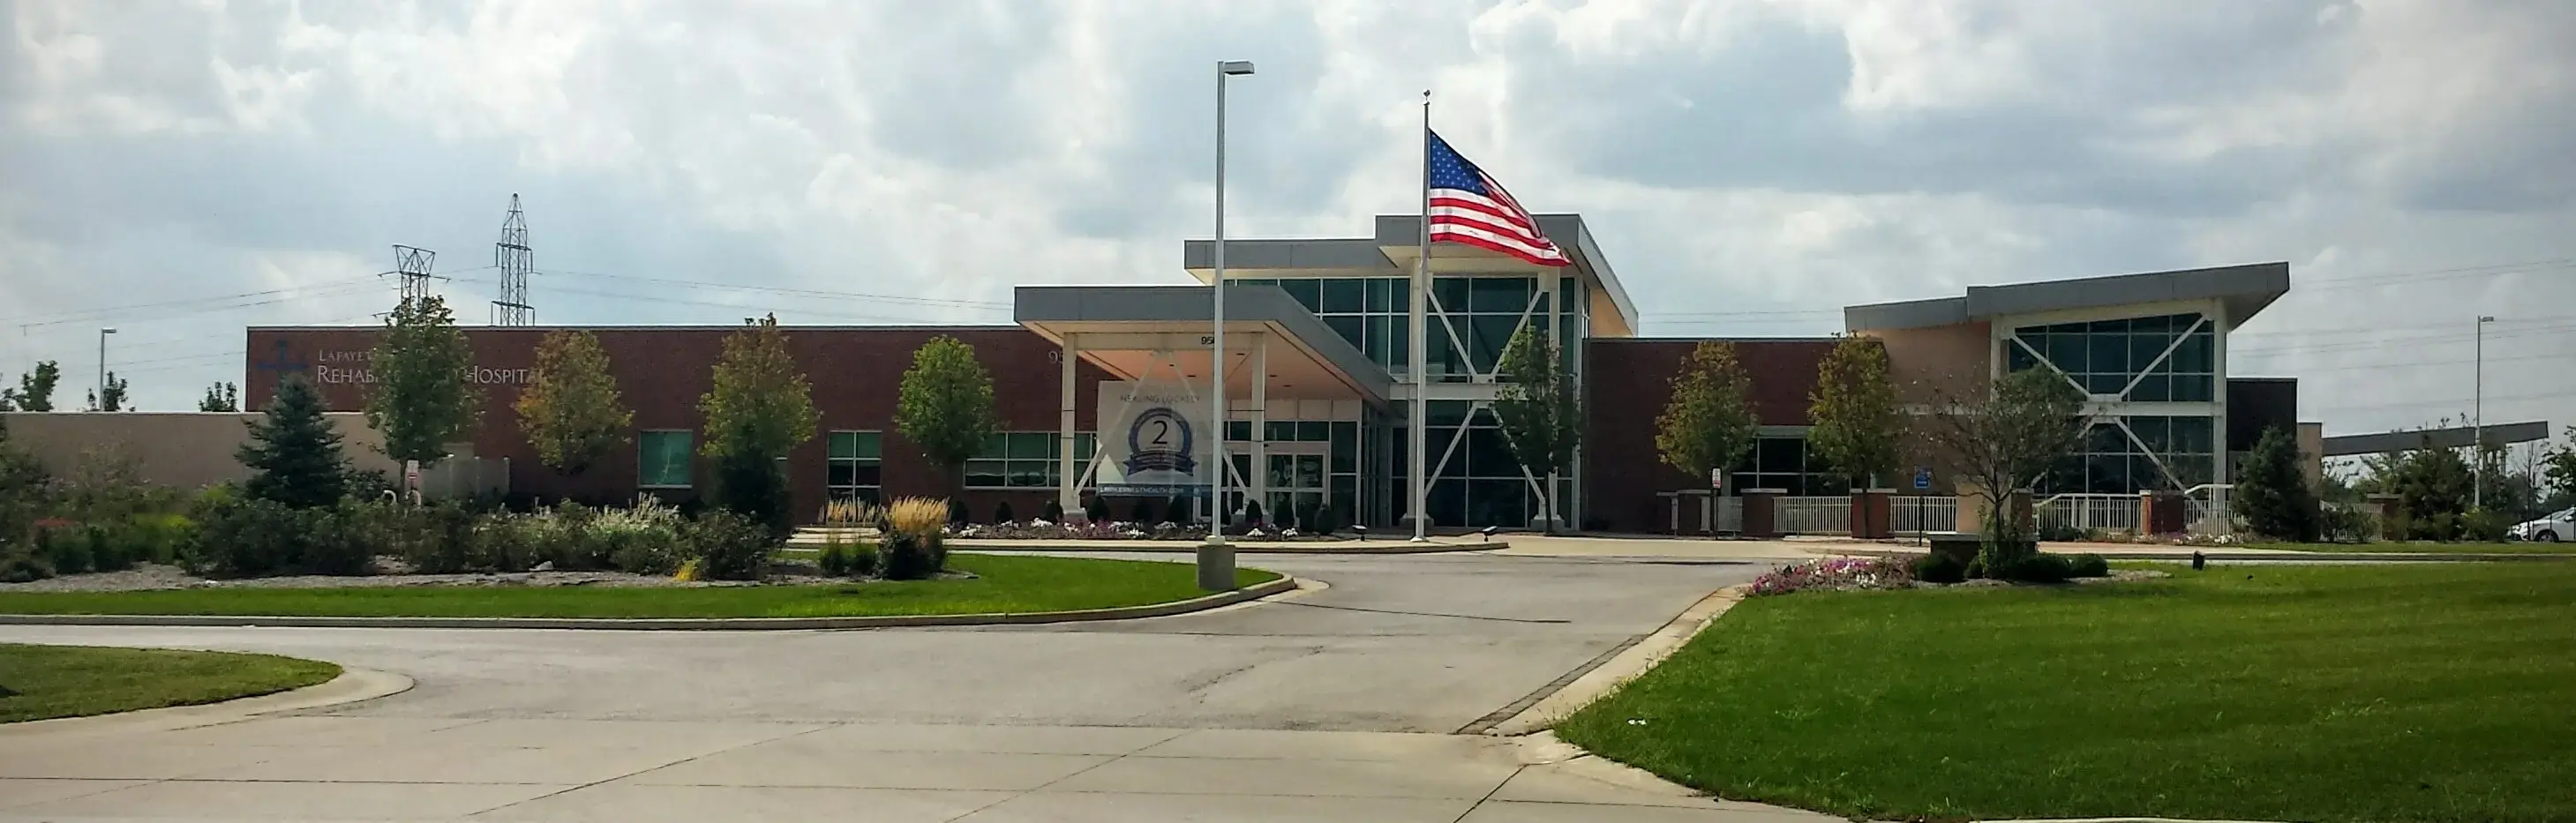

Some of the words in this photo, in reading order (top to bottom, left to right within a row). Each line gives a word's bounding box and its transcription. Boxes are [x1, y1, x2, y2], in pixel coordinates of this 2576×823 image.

[1201, 336, 1214, 345] 95
[319, 349, 372, 362] LAFAYET
[1152, 420, 1168, 445] 2
